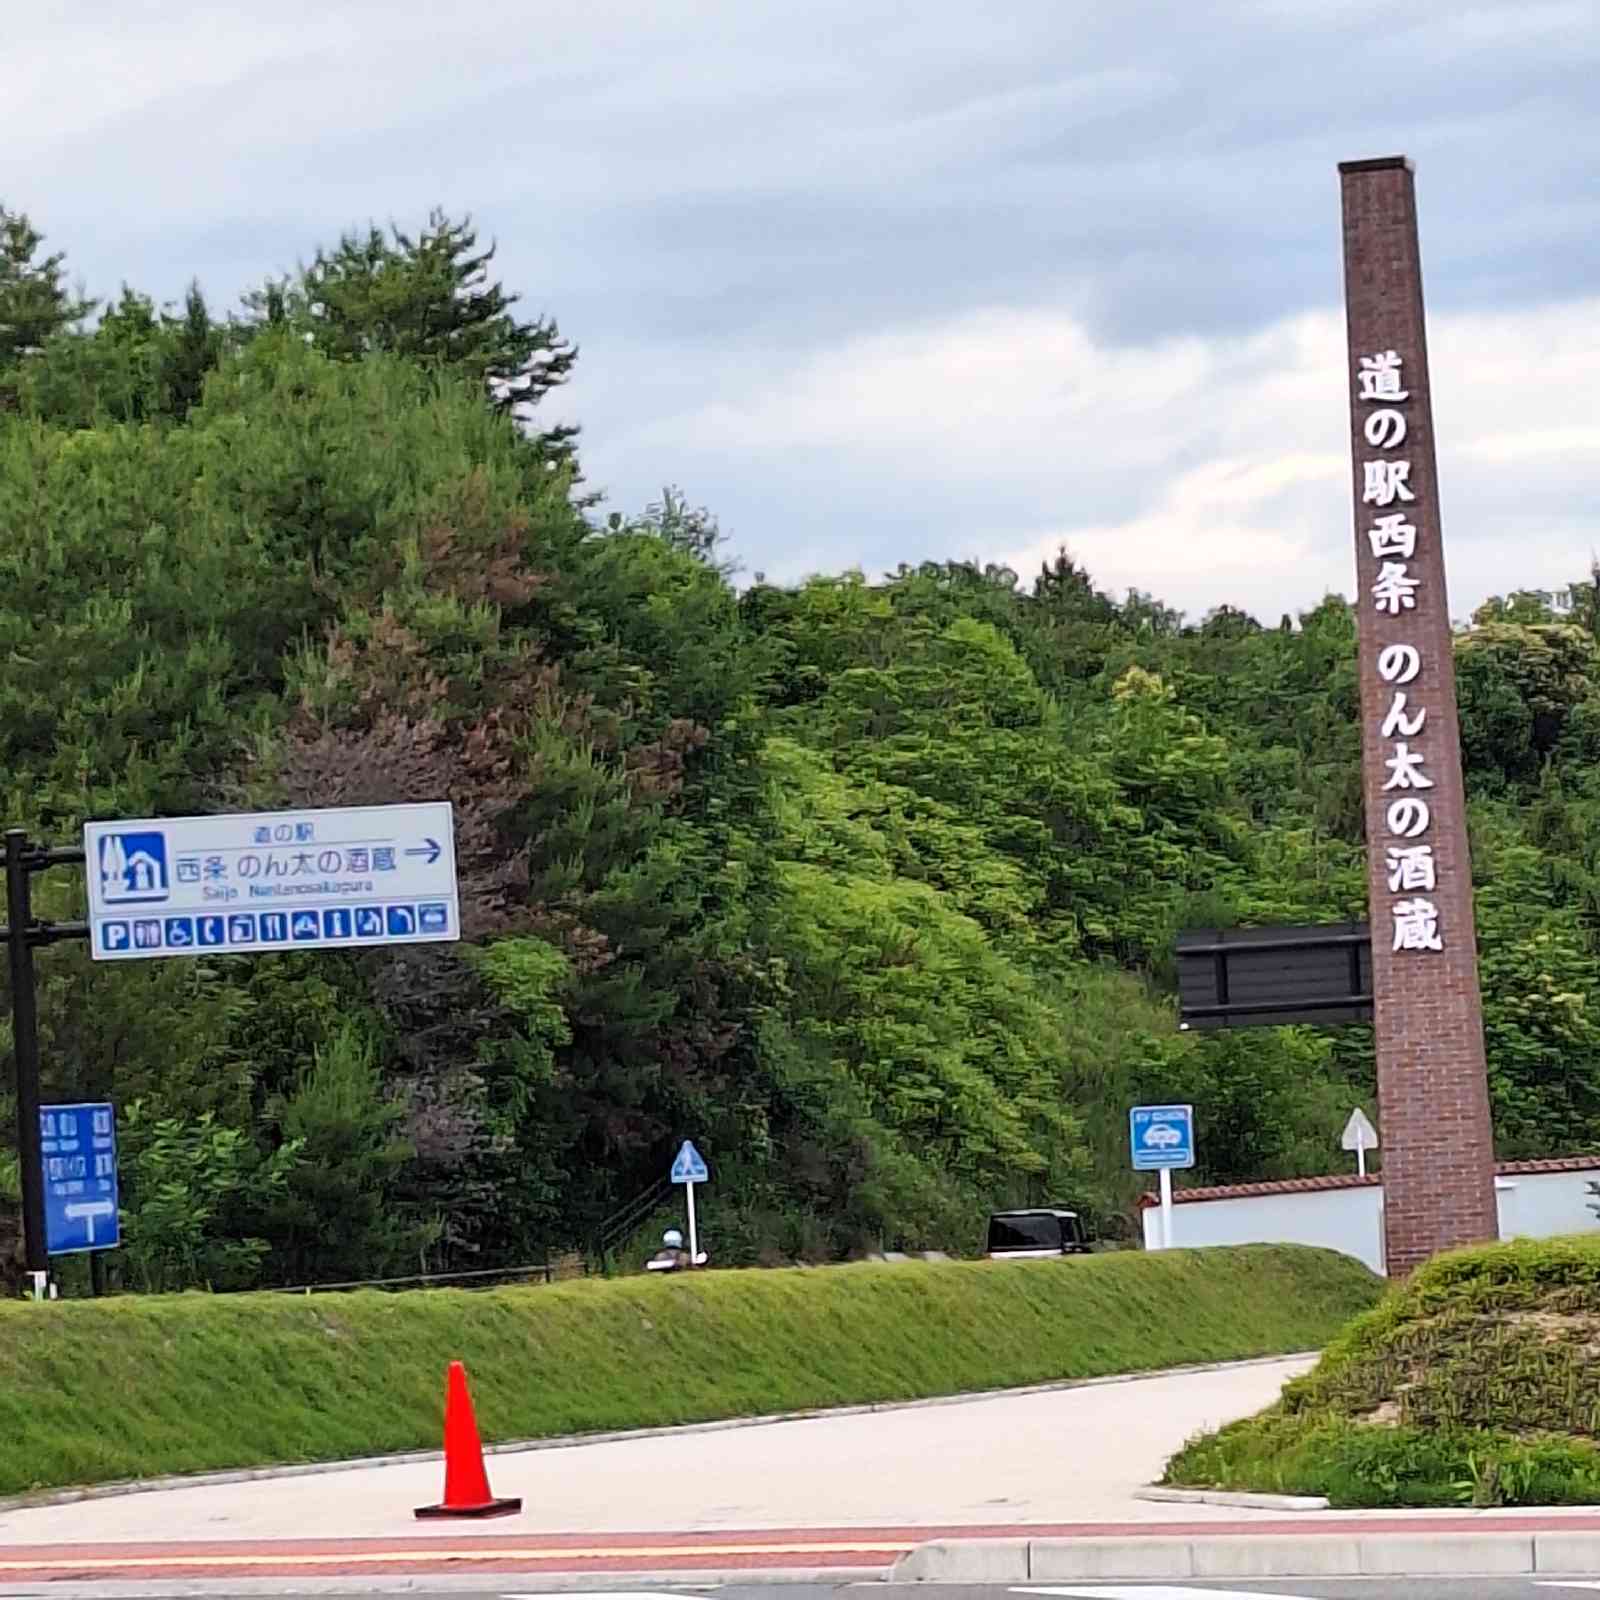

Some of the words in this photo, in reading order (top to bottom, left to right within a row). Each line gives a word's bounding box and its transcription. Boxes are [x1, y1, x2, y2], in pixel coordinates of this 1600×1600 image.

[1378, 644, 1443, 951] のん太の酒蔵
[254, 822, 315, 843] 道の駅
[175, 855, 228, 883] 西条
[237, 847, 396, 878] のん太の酒蔵
